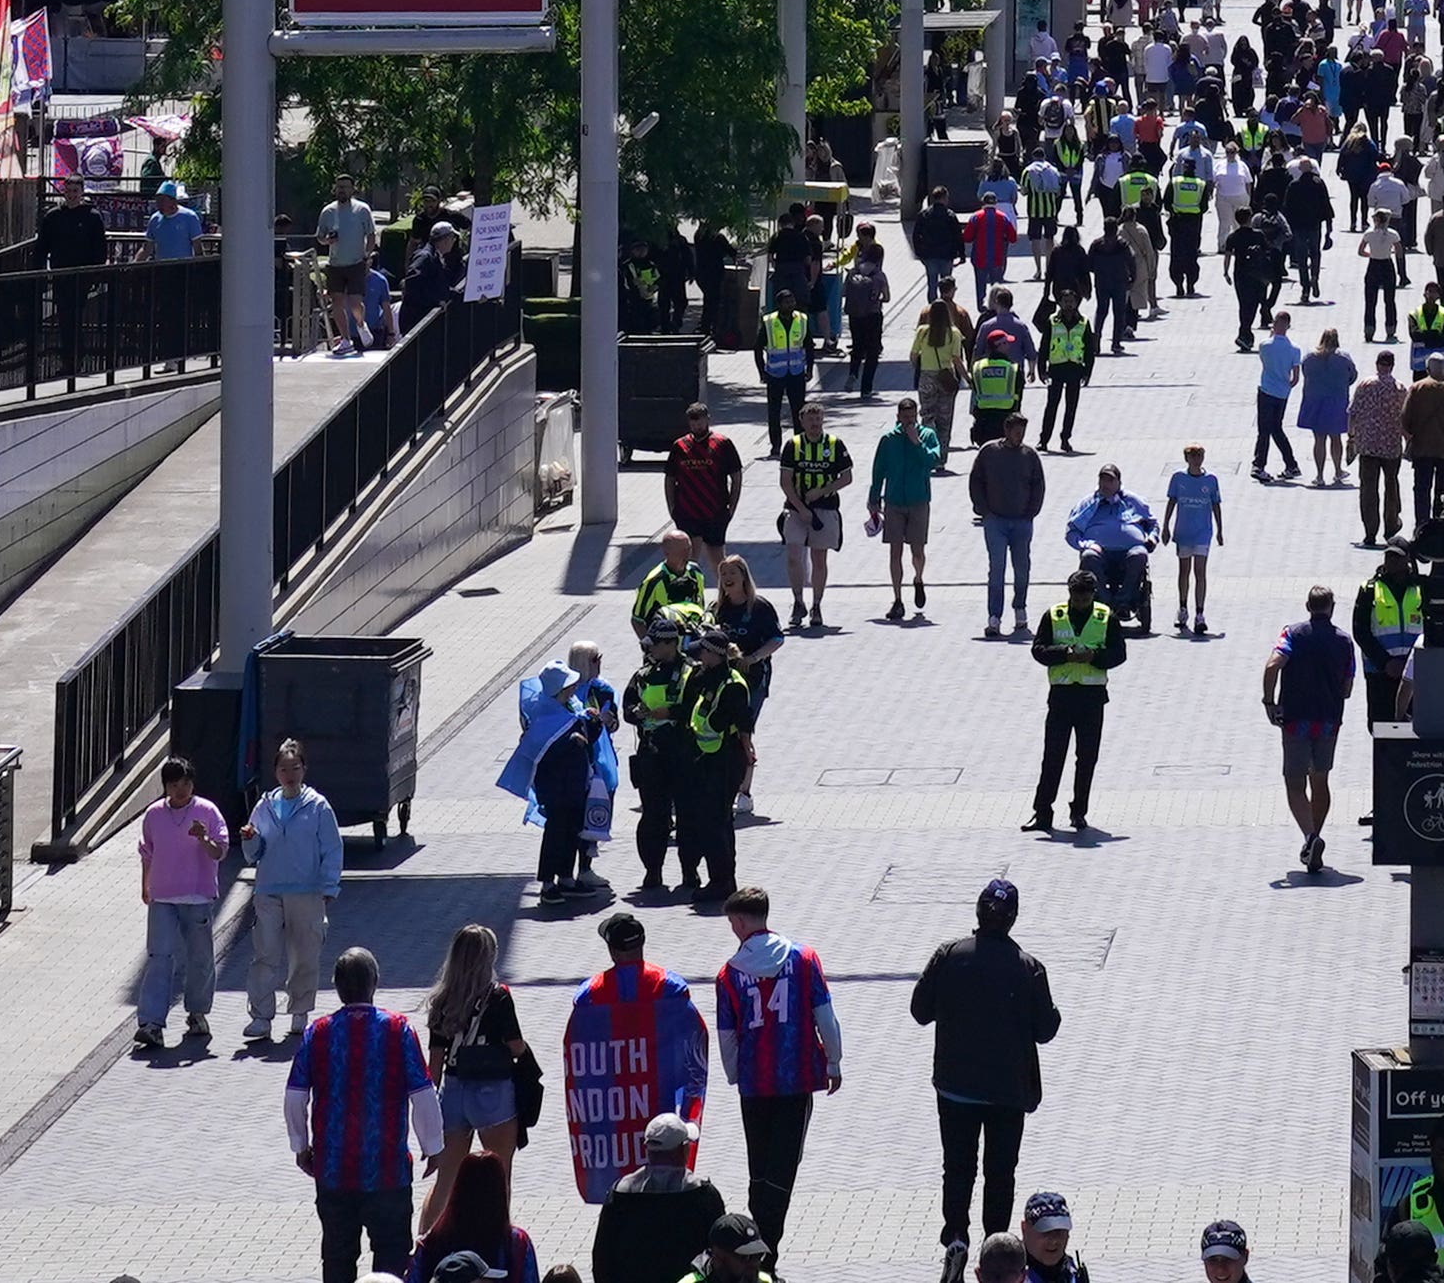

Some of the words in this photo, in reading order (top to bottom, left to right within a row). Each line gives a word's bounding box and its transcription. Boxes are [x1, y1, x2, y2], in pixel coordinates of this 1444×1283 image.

[983, 367, 1005, 377] POLICE
[1412, 751, 1431, 759] Share
[746, 977, 789, 1029] 14
[1395, 1091, 1426, 1106] Off
